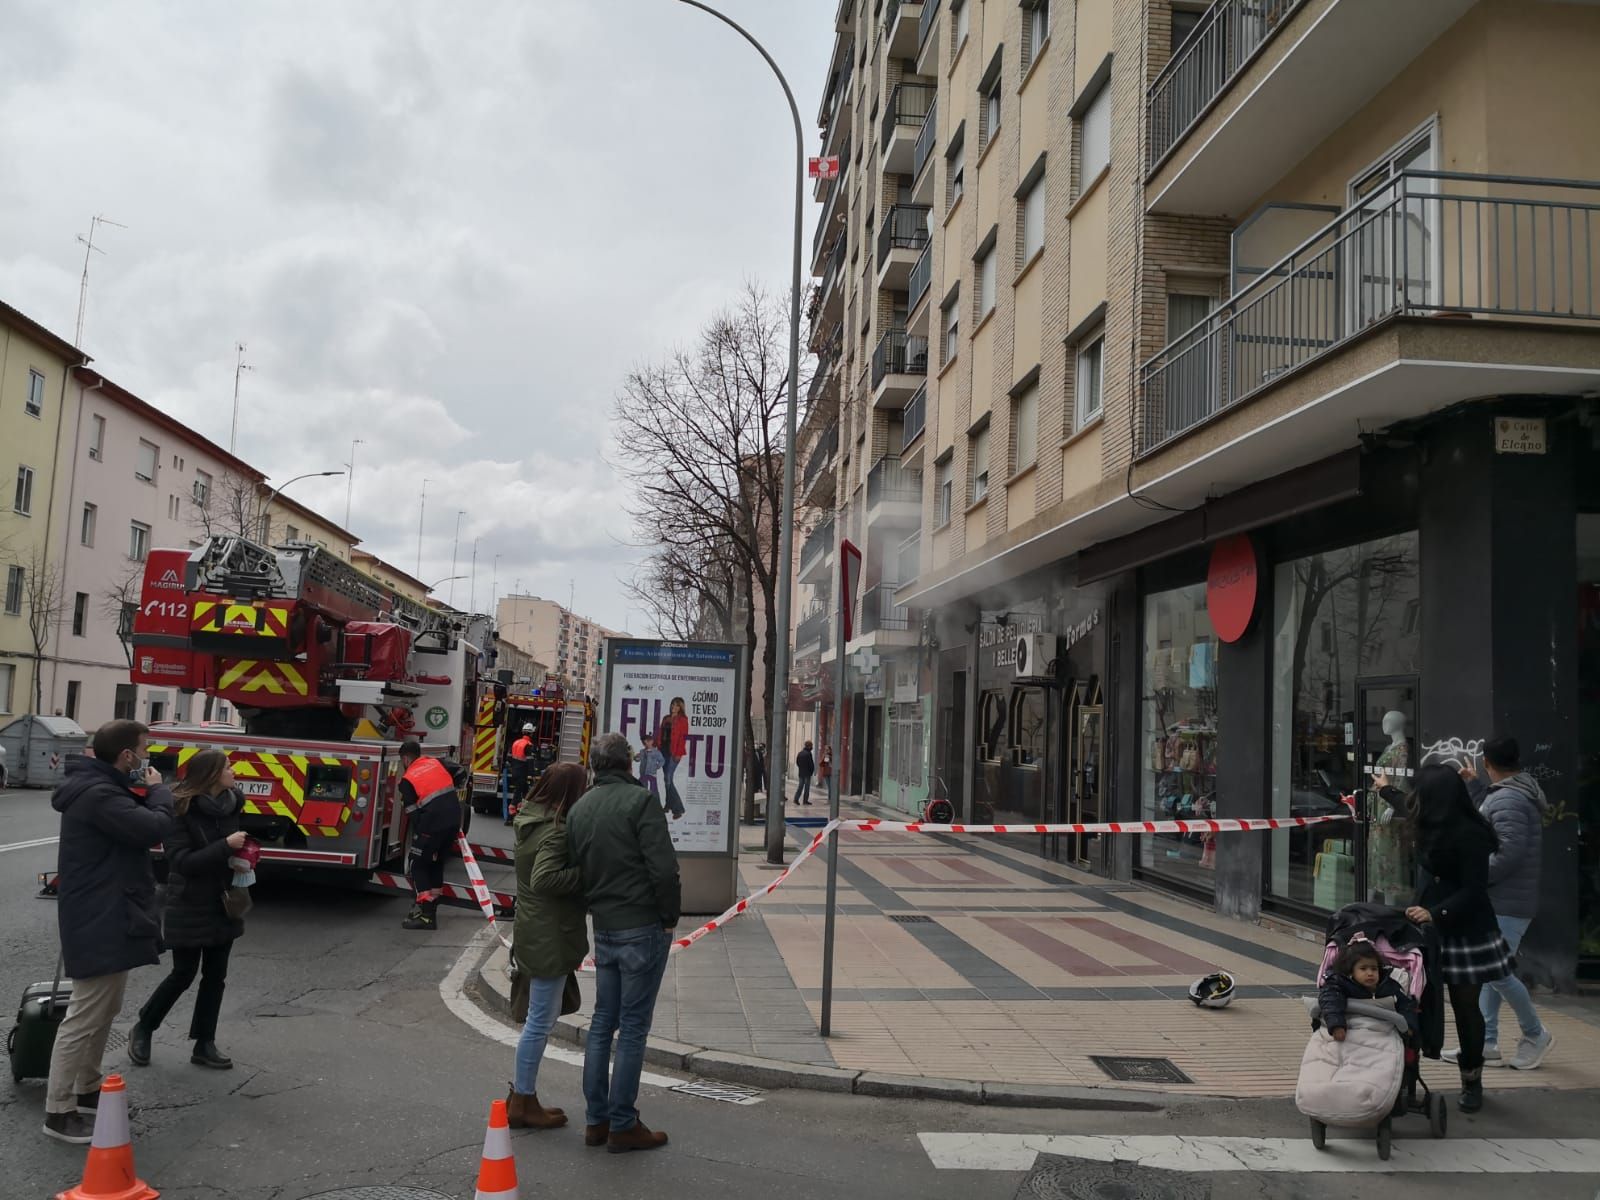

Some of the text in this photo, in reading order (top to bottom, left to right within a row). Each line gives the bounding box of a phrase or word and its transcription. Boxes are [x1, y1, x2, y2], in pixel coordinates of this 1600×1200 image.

[1513, 422, 1539, 431] Calle
[1520, 432, 1530, 441] de
[1501, 439, 1542, 450] Elcano
[158, 602, 187, 618] 112
[997, 647, 1016, 667] BELLE
[692, 691, 719, 704] ¿CÓMO
[692, 704, 717, 715] TE VES
[620, 697, 661, 738] FU
[691, 716, 727, 728] EN 2030?
[685, 734, 726, 779] TU
[249, 783, 269, 794] KYP
